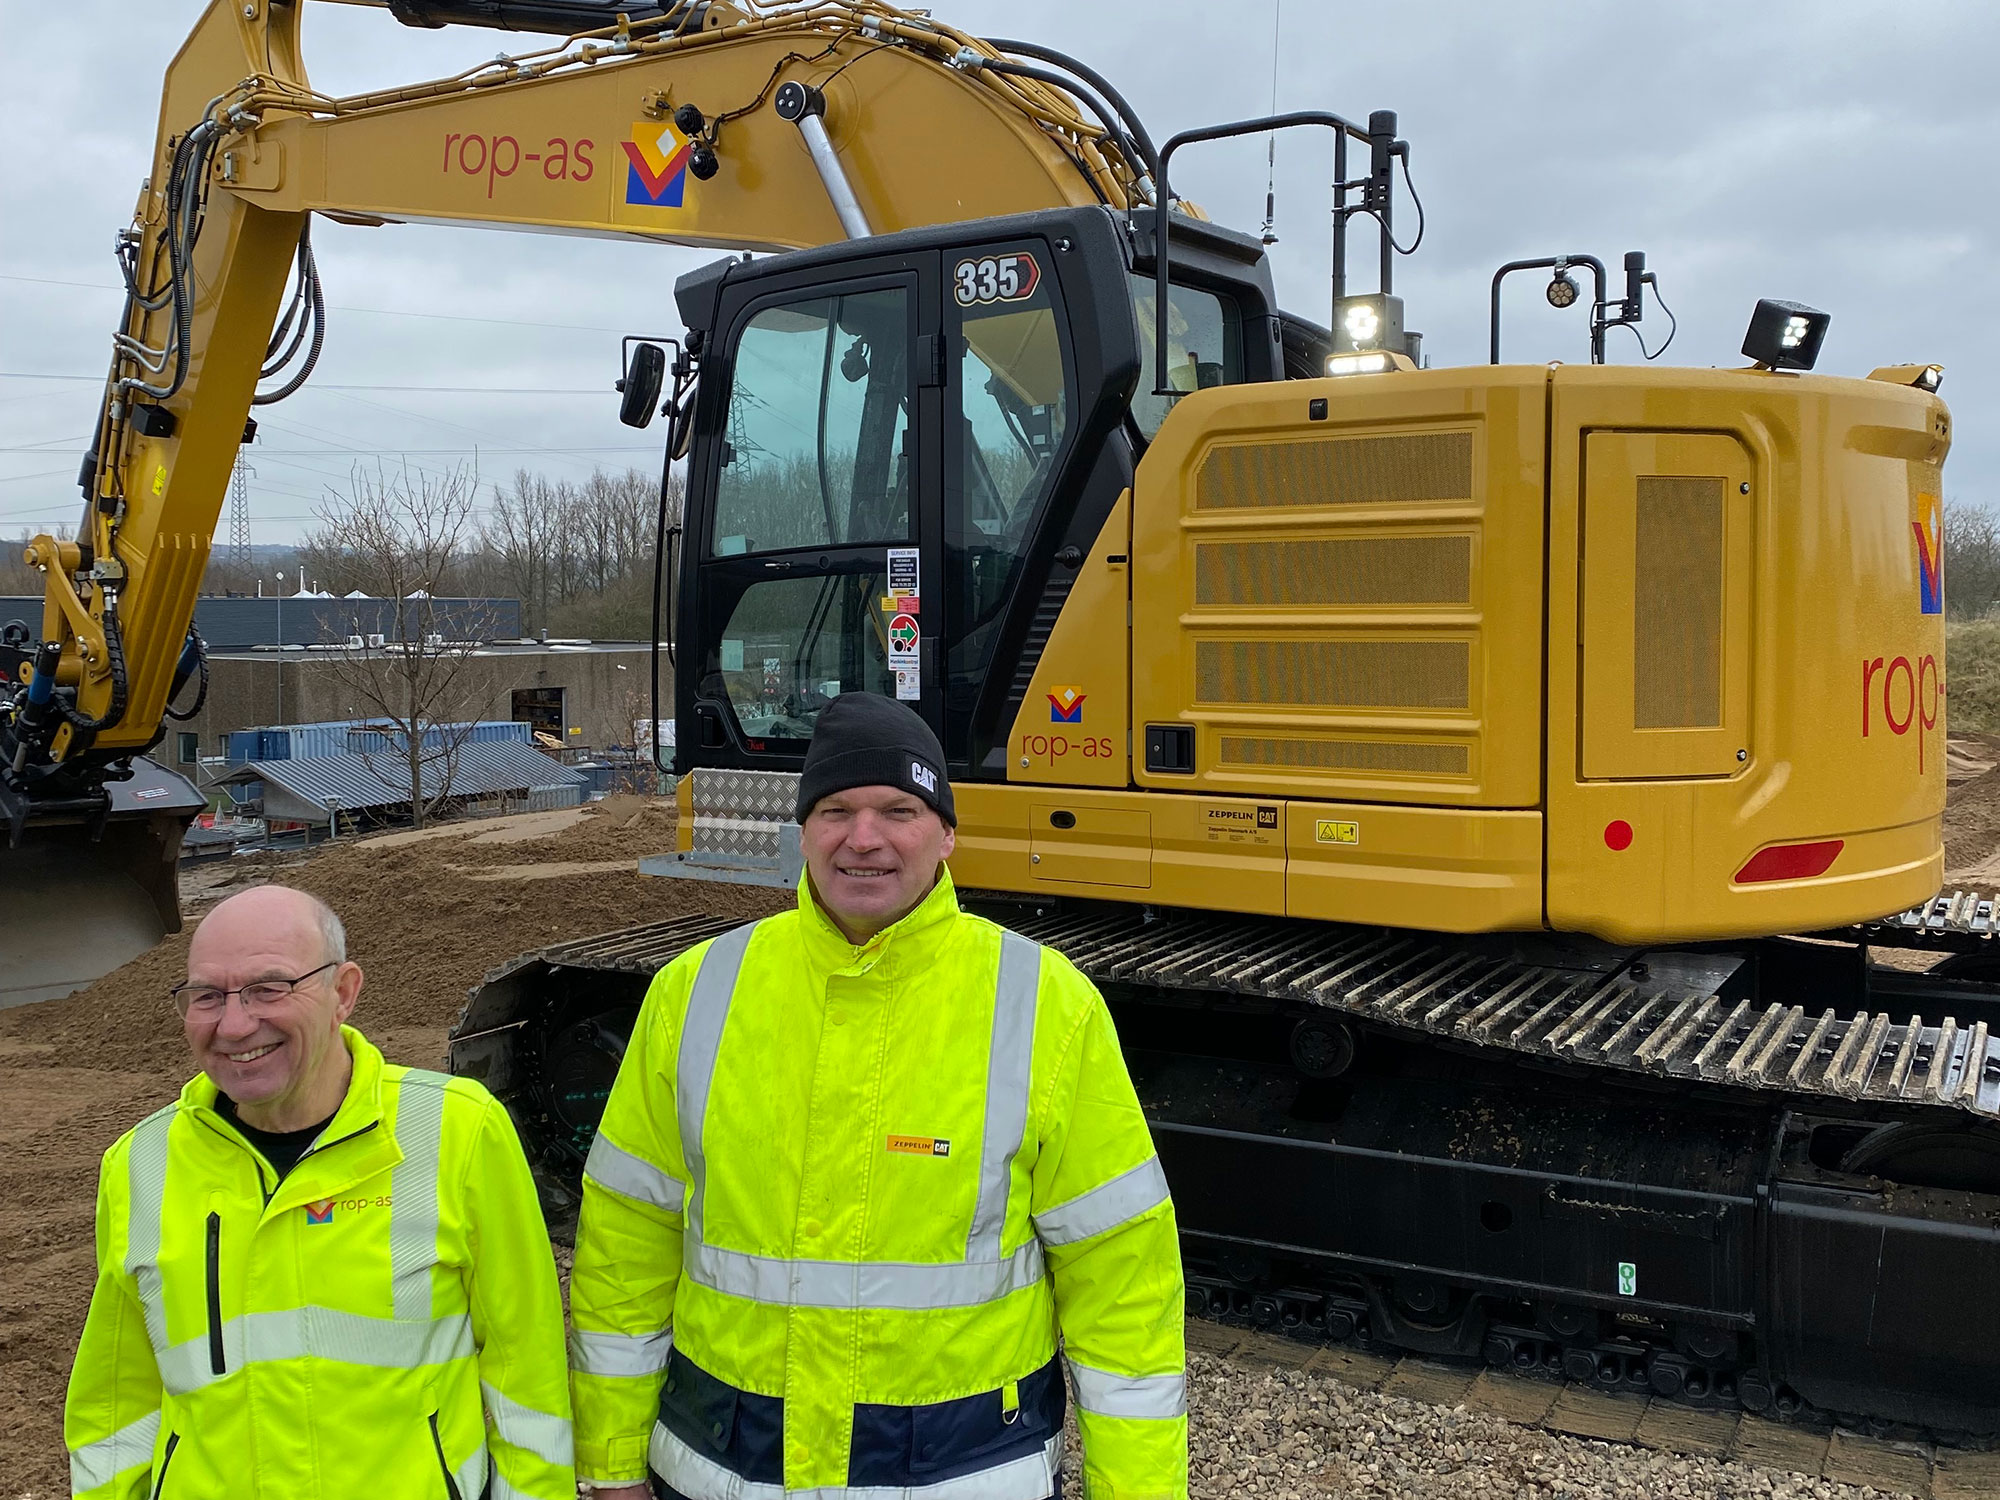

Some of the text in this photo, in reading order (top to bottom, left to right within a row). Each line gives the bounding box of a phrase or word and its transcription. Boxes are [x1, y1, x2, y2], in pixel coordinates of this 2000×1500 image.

[443, 133, 595, 199] rop-as
[957, 257, 1019, 302] 335
[1022, 735, 1113, 767] rop-as
[911, 761, 938, 793] CAT
[1208, 810, 1276, 824] ZEPPELIN CAT
[894, 1141, 949, 1153] ZEPPELIN CAT
[340, 1196, 392, 1214] rop-as
